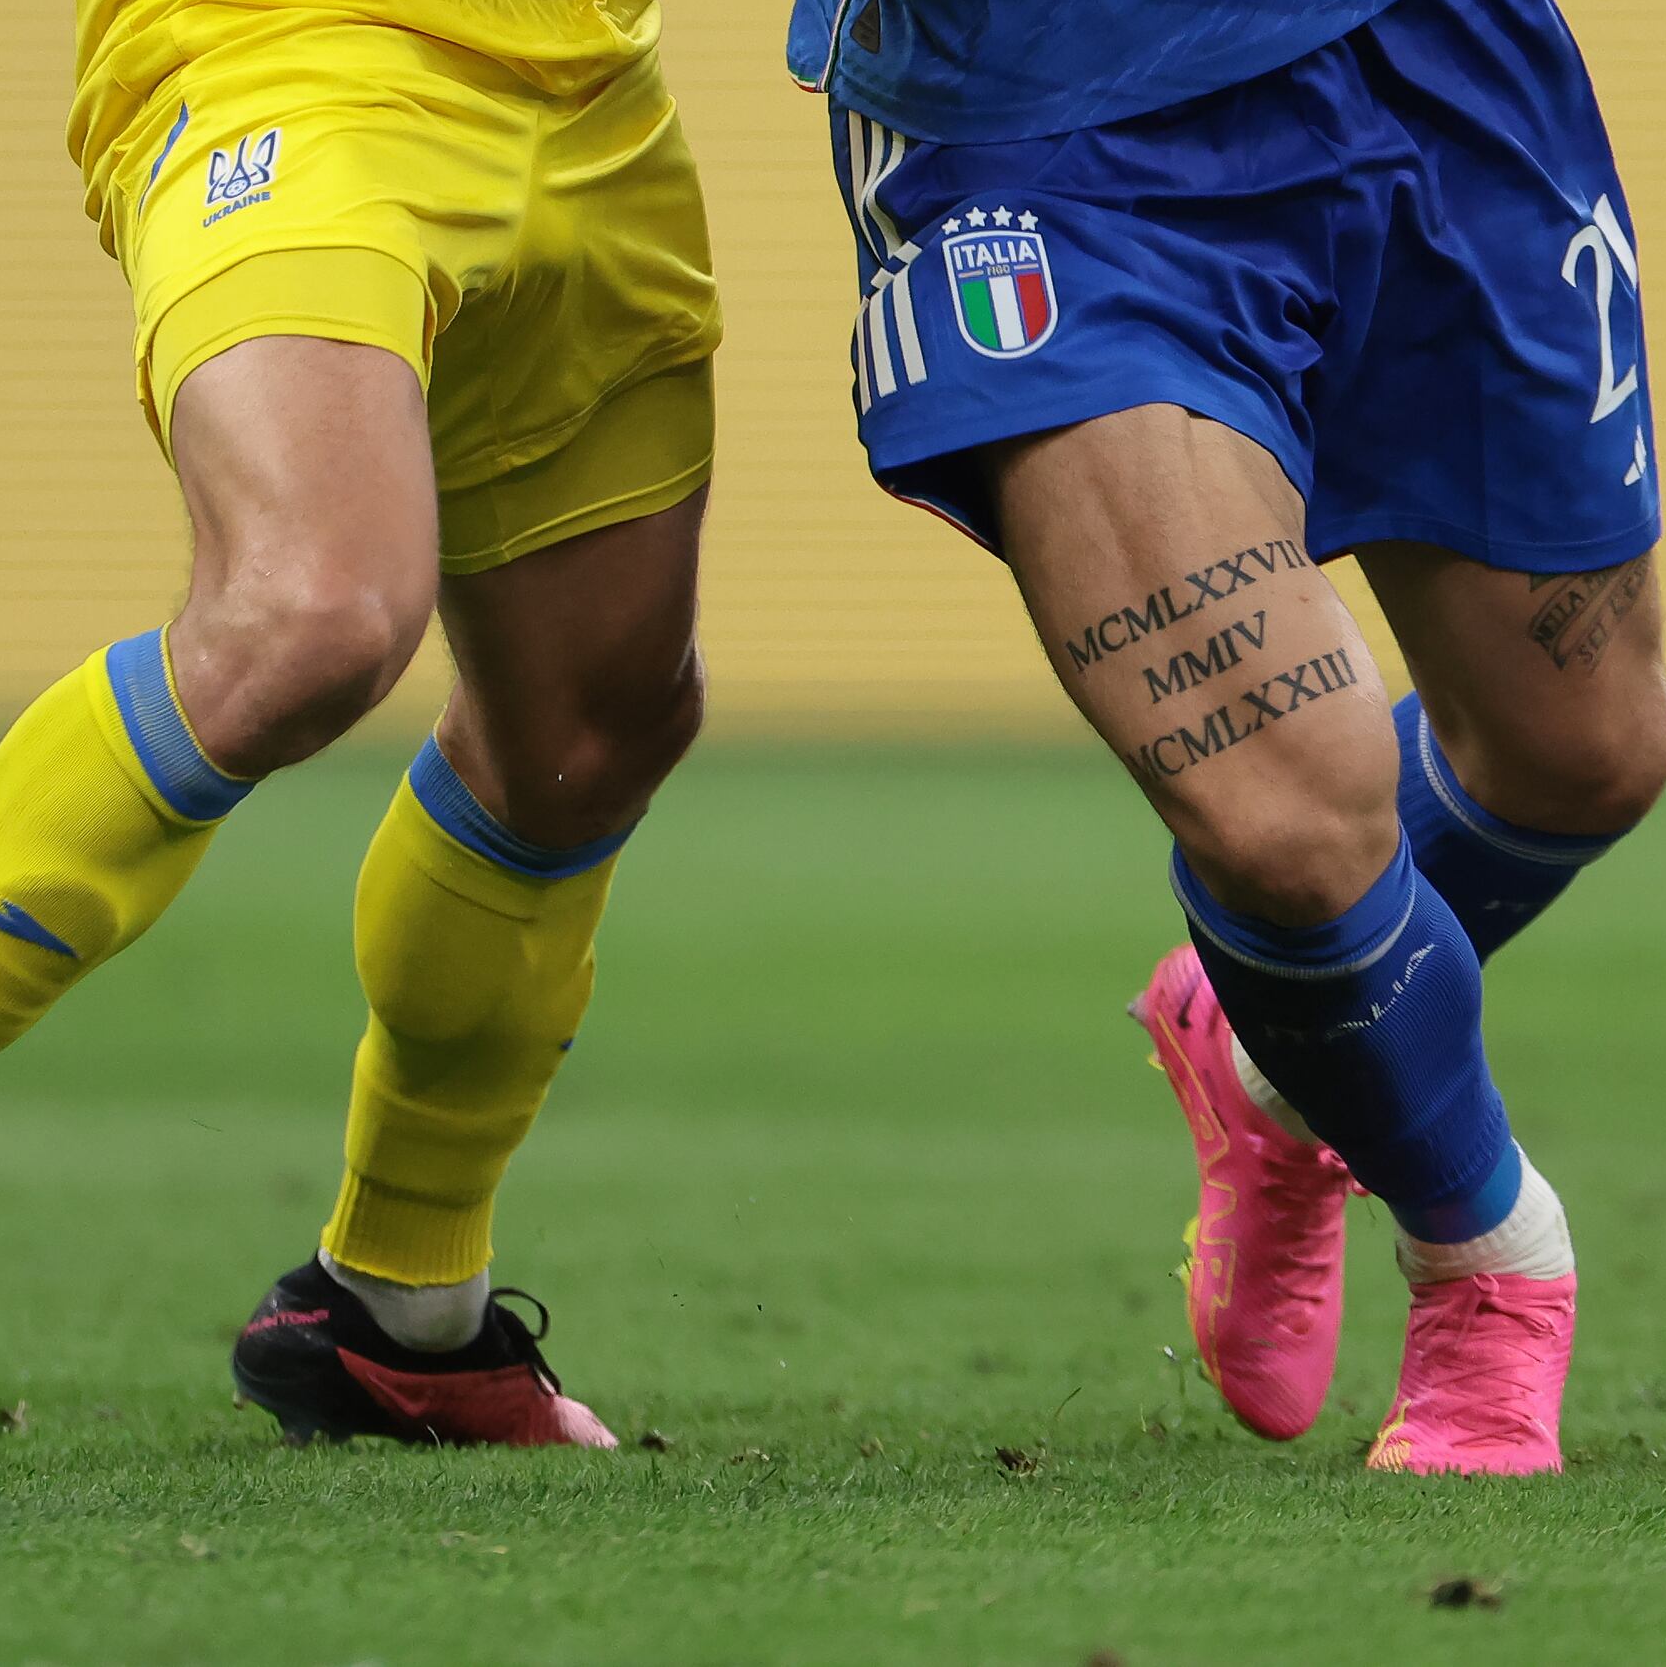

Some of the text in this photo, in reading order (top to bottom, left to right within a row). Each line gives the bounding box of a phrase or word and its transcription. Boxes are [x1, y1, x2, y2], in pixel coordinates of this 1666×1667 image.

[202, 191, 271, 228] UKRAINE
[953, 239, 1038, 271] ITALIA
[1064, 538, 1308, 674] MCMLXXVII
[1142, 609, 1267, 705] MMIV
[1128, 647, 1358, 783] MCMLXXIII
